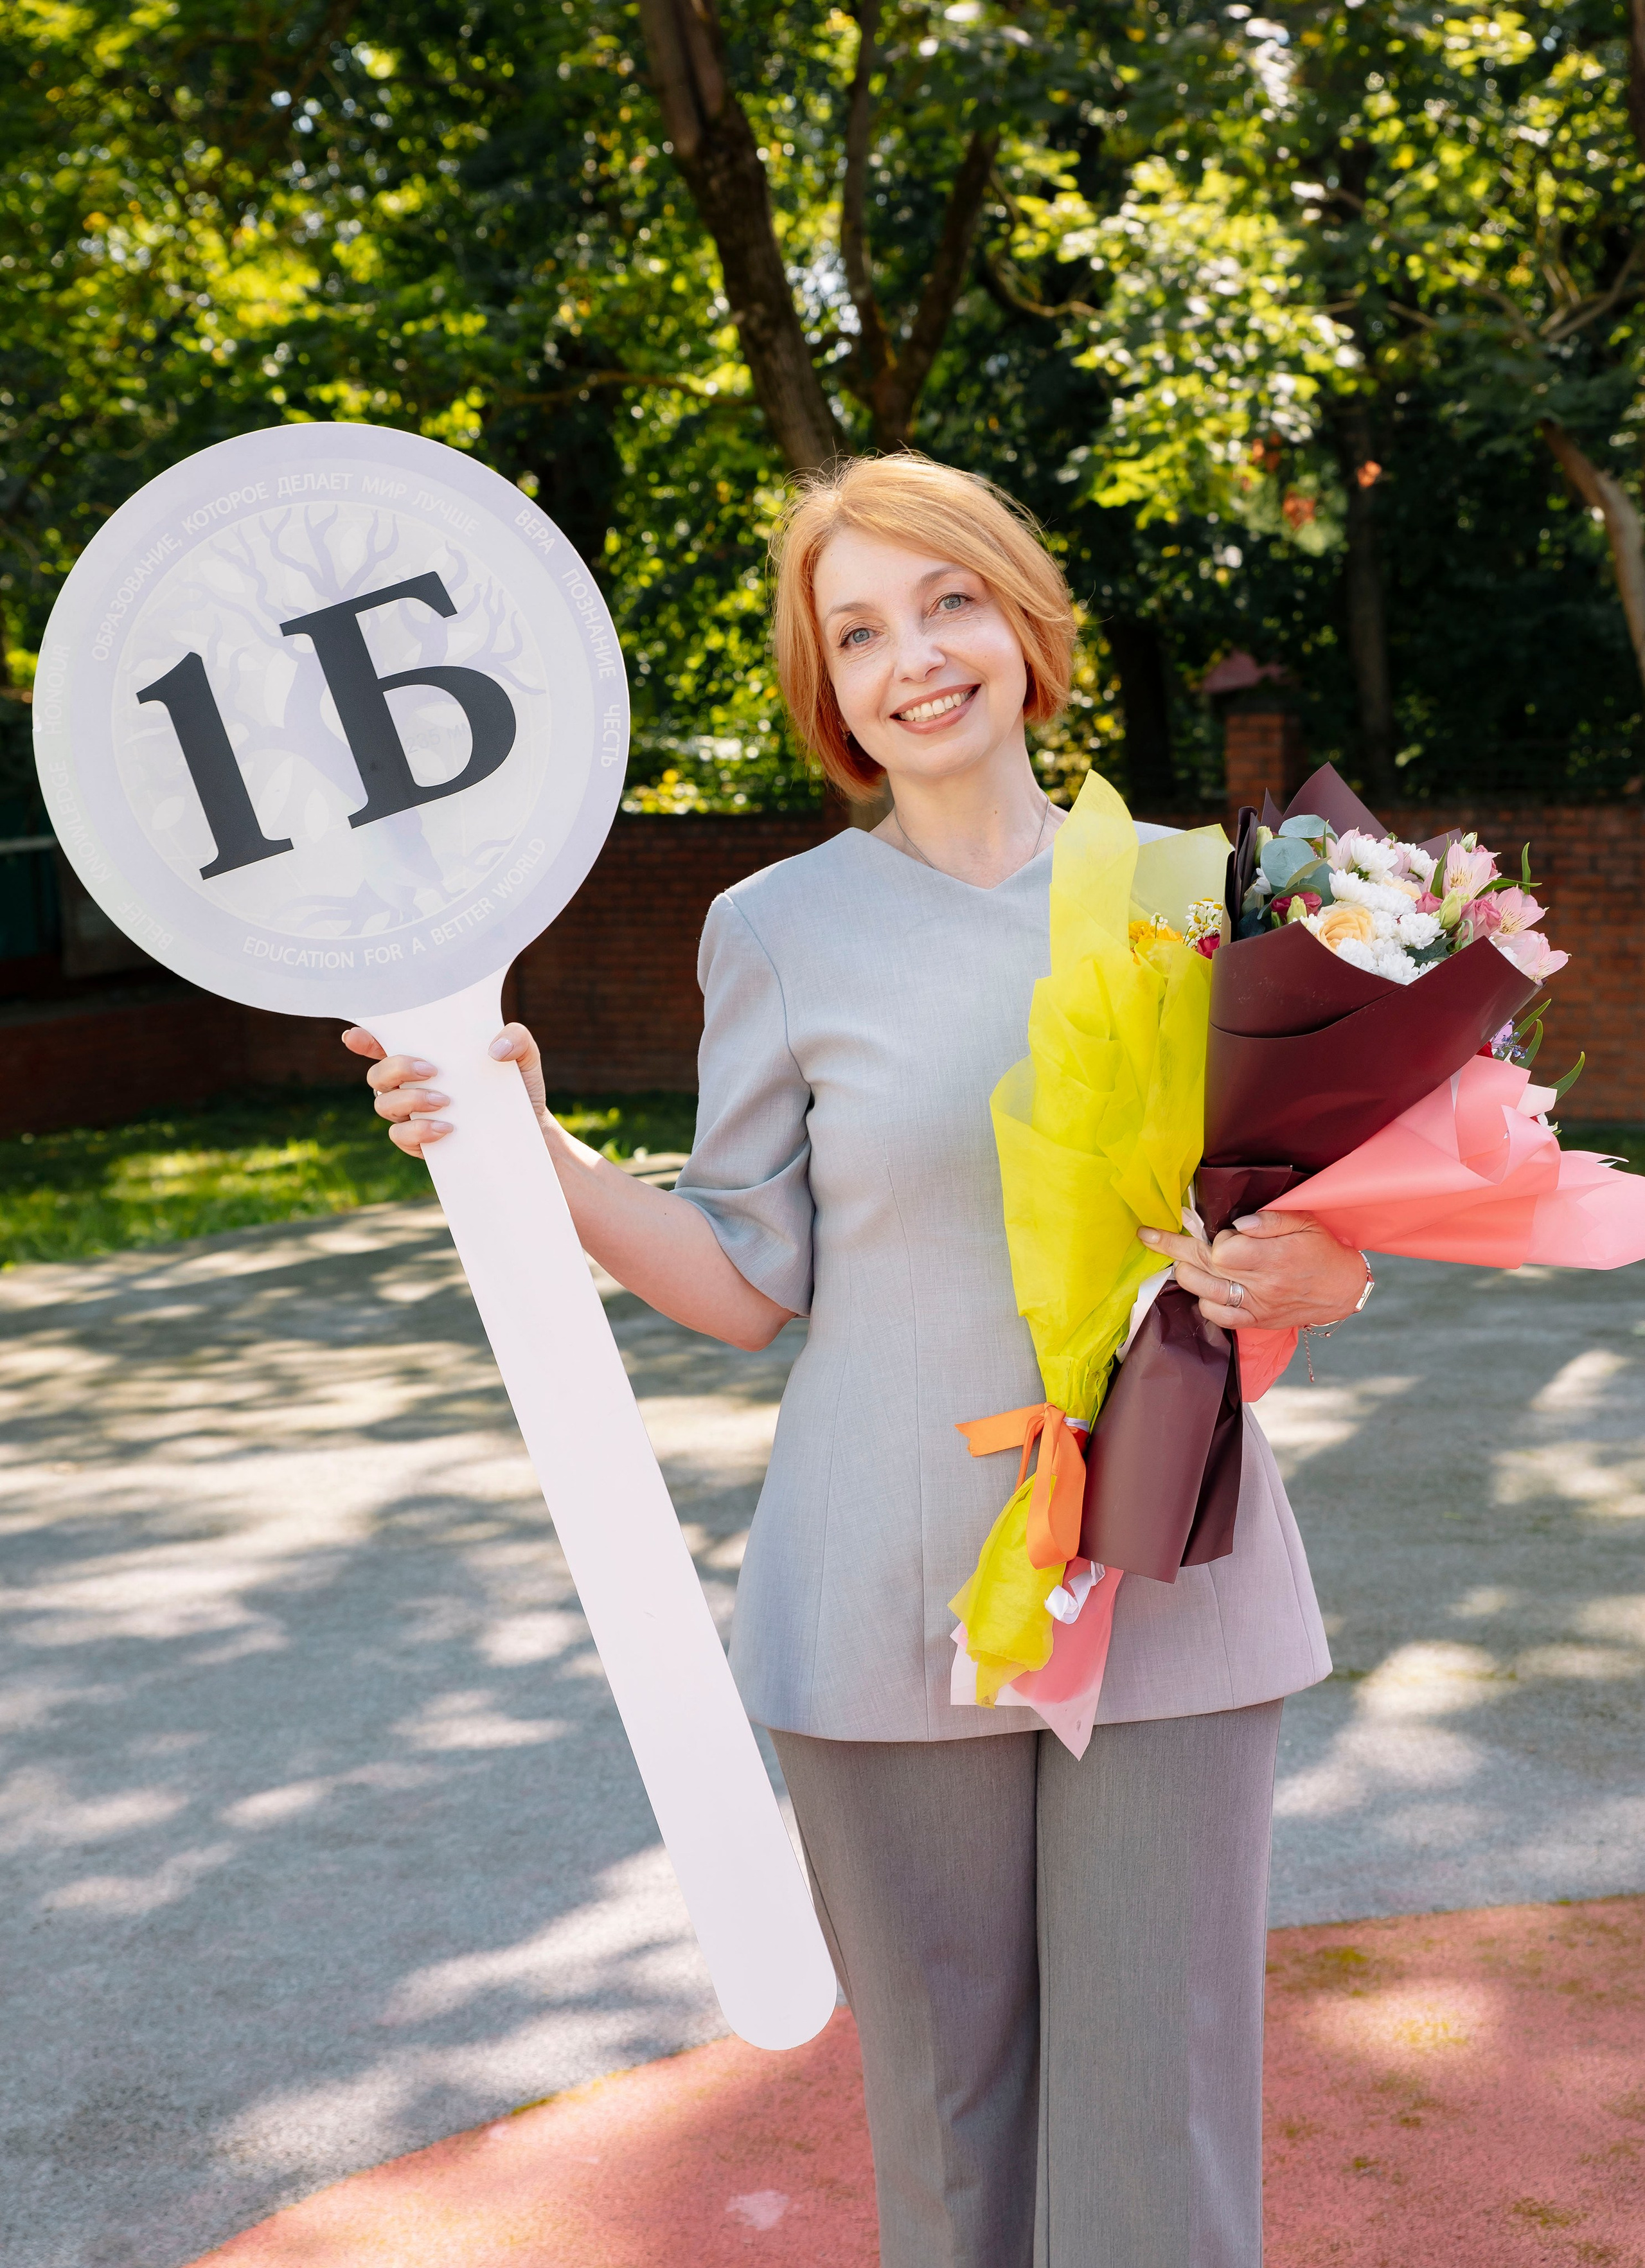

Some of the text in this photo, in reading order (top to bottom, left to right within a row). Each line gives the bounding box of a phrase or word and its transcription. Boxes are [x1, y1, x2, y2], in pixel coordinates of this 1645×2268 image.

[92, 472, 480, 661] ОБРАЗОВАНИЕ, КОТОРОЕ ДЕЛАЕТ МИР ЛУЧШЕ
[513, 508, 621, 768] ВЕРА ПОЗНАНИЕ ЧЕСТЬ
[44, 644, 174, 951] BELIEF KNOWLEDGE HONOUR
[241, 837, 546, 969] EDUCATION FOR A BETTER WORLD
